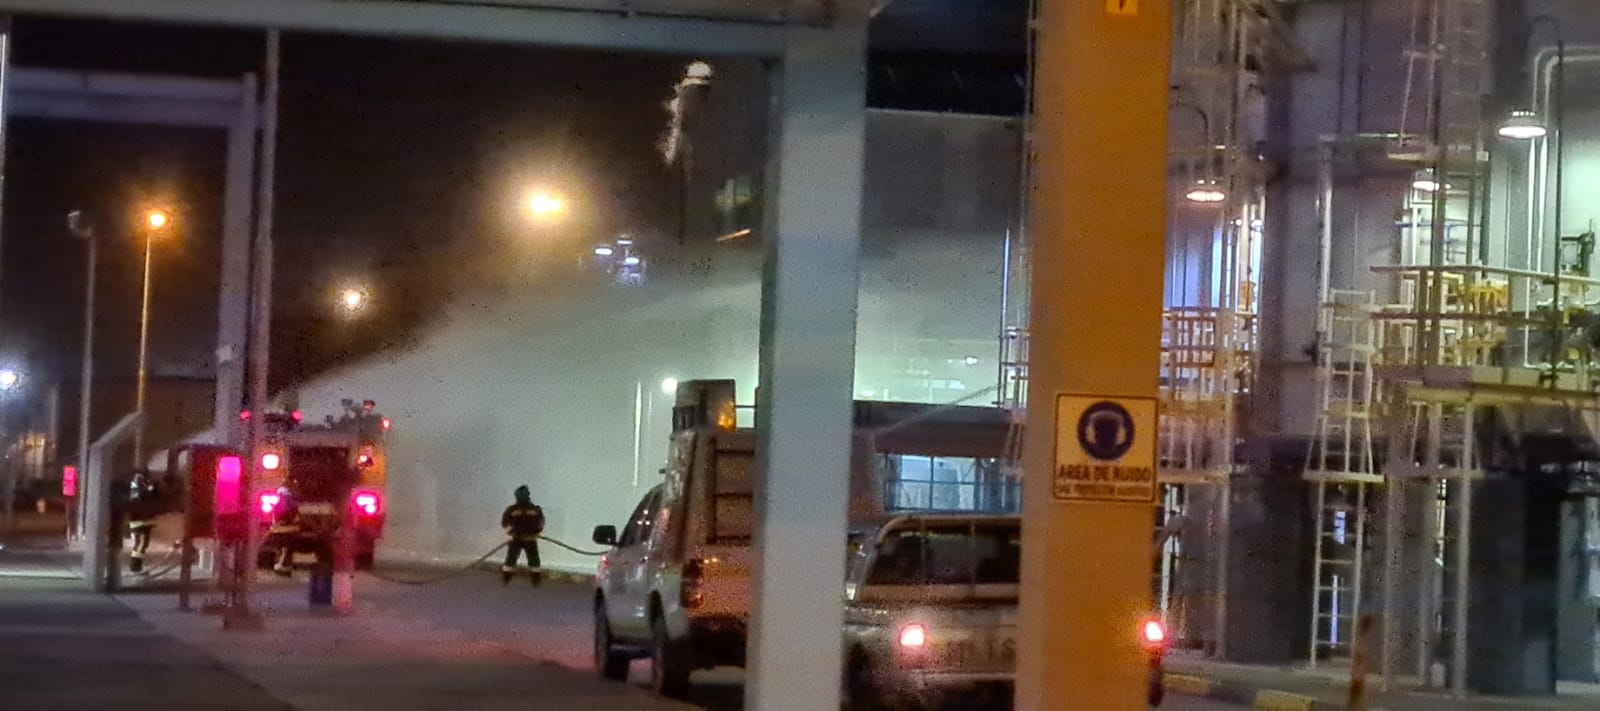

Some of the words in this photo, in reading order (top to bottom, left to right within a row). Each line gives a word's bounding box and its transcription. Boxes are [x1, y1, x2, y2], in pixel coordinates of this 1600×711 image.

[1058, 464, 1091, 480] AREA
[1094, 465, 1110, 481] DE
[1112, 466, 1152, 482] RUIDO
